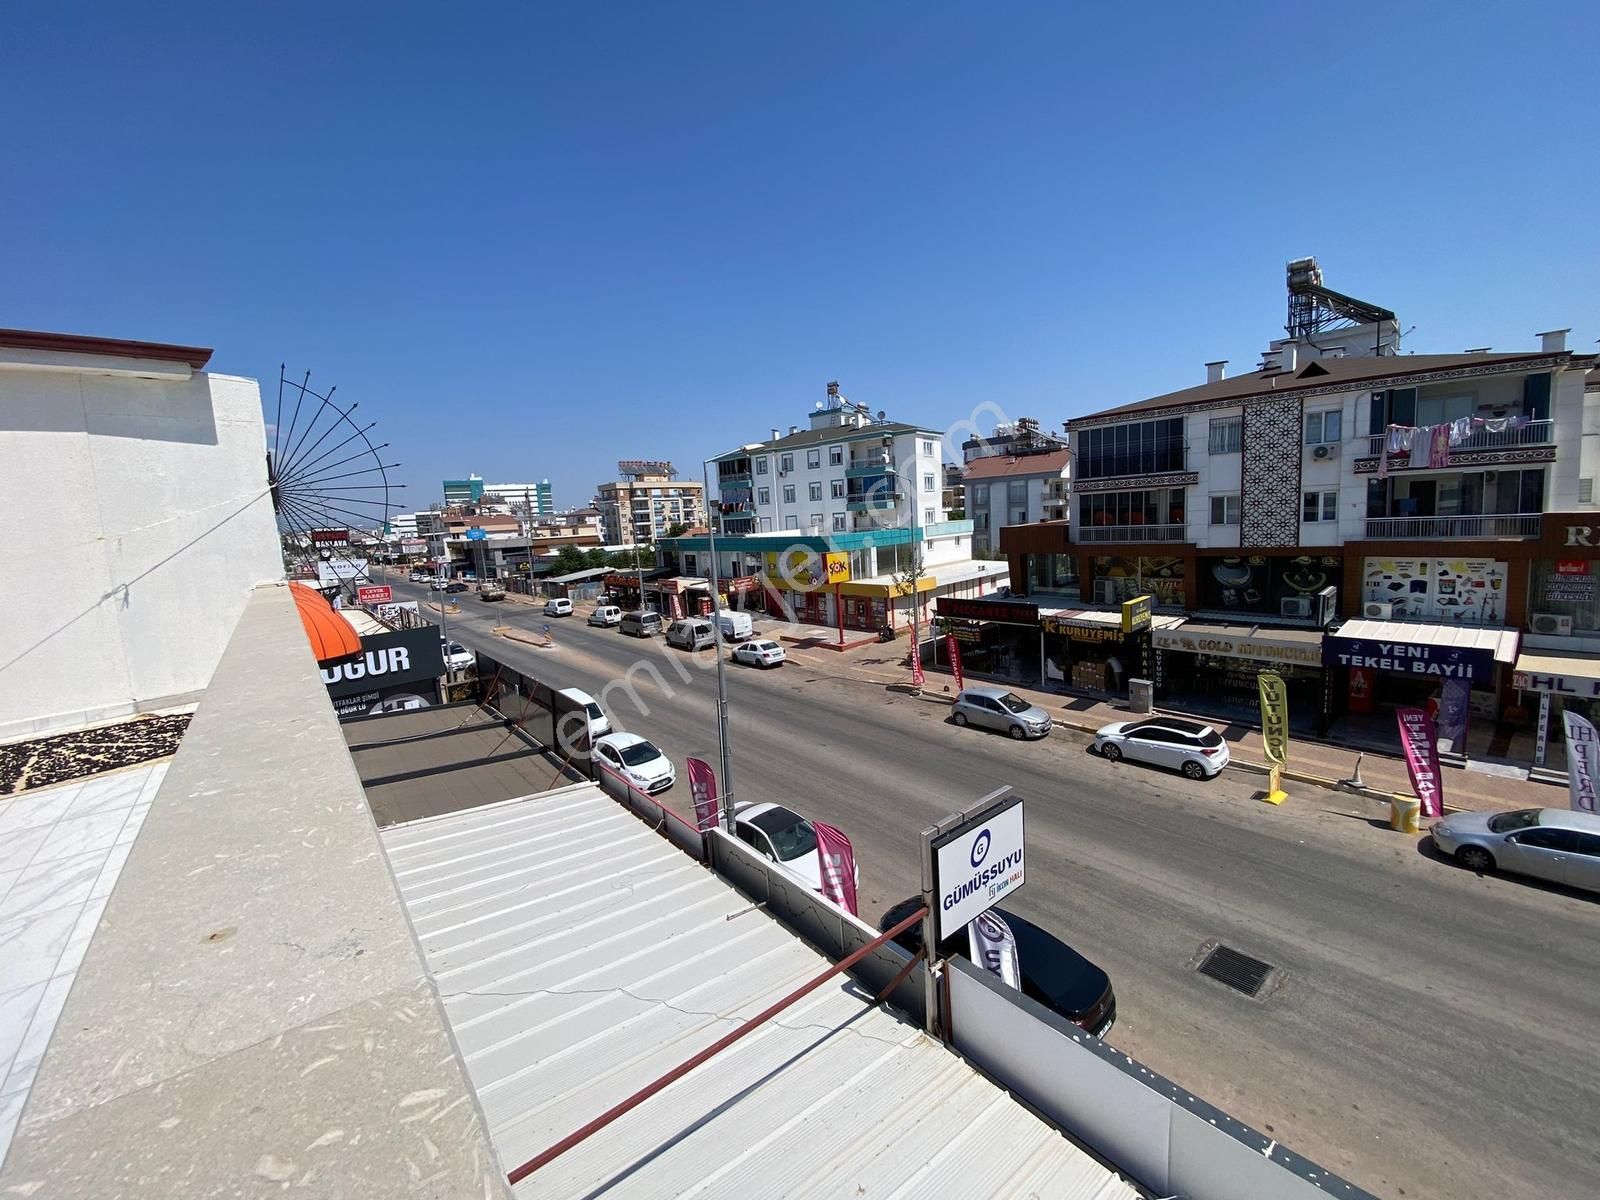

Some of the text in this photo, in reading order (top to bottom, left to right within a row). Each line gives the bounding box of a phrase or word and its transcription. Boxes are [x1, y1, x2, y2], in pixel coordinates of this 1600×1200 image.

[1563, 526, 1600, 546] R
[829, 561, 847, 576] ŞOK
[361, 592, 390, 601] MARKET
[1059, 624, 1125, 644] KURUYEMİŞ
[1198, 638, 1233, 653] GOLD
[1338, 654, 1405, 671] TEKEL
[1532, 675, 1575, 693] HL
[943, 848, 1022, 911] GÜMÜŞSUYU
